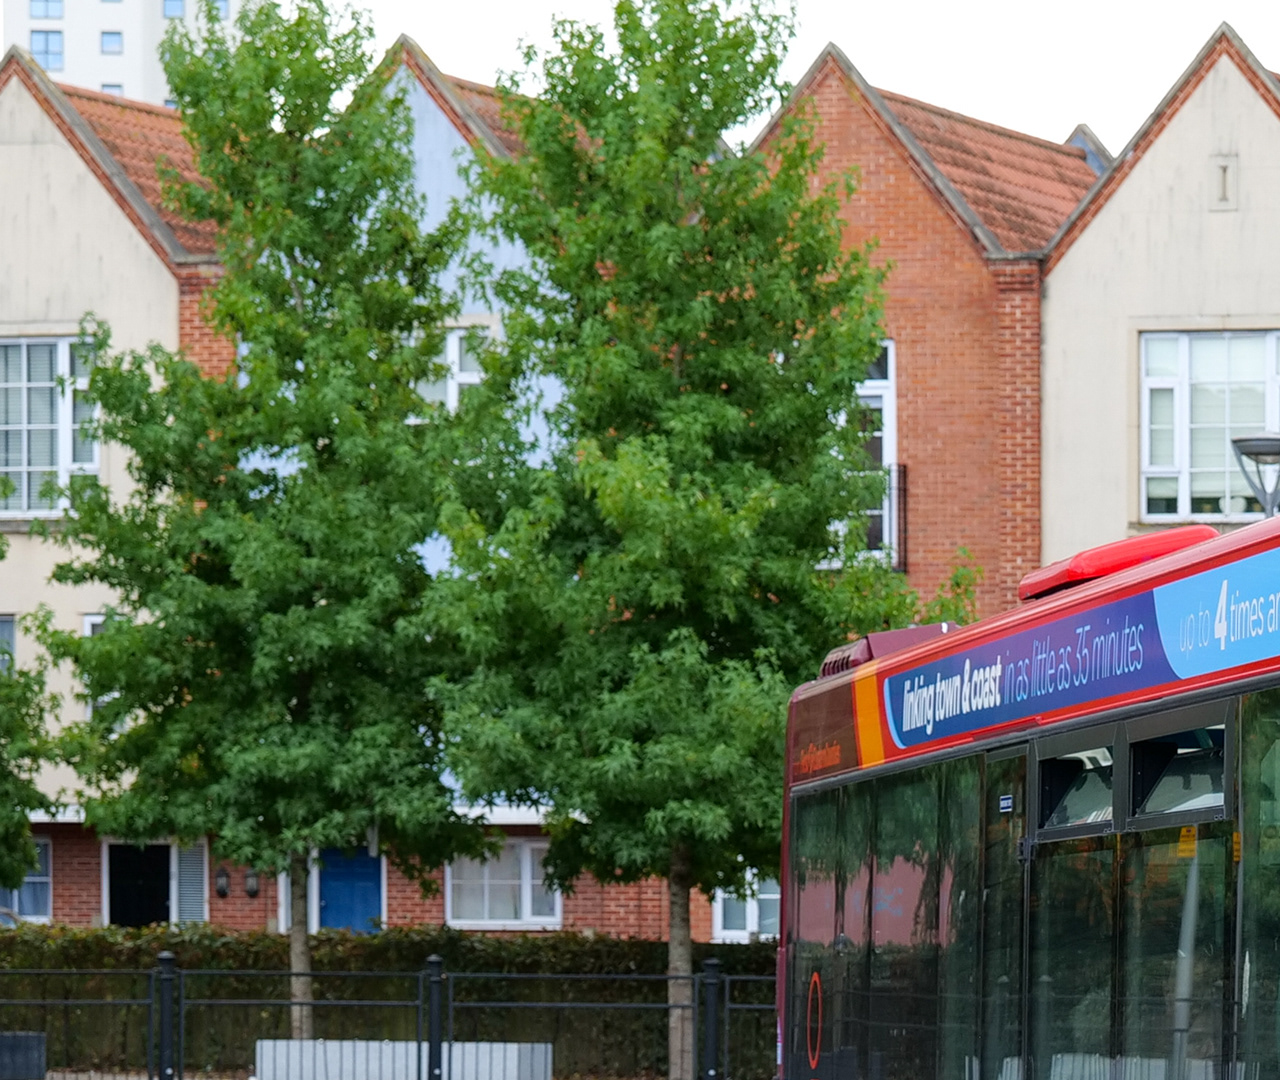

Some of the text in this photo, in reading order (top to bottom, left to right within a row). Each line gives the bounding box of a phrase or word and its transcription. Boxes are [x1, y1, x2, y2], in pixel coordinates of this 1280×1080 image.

[1199, 604, 1210, 648] to
[1214, 579, 1228, 650] 4
[1230, 589, 1265, 642] times
[902, 618, 1145, 735] linking town & coast in as little as 35 minutes
